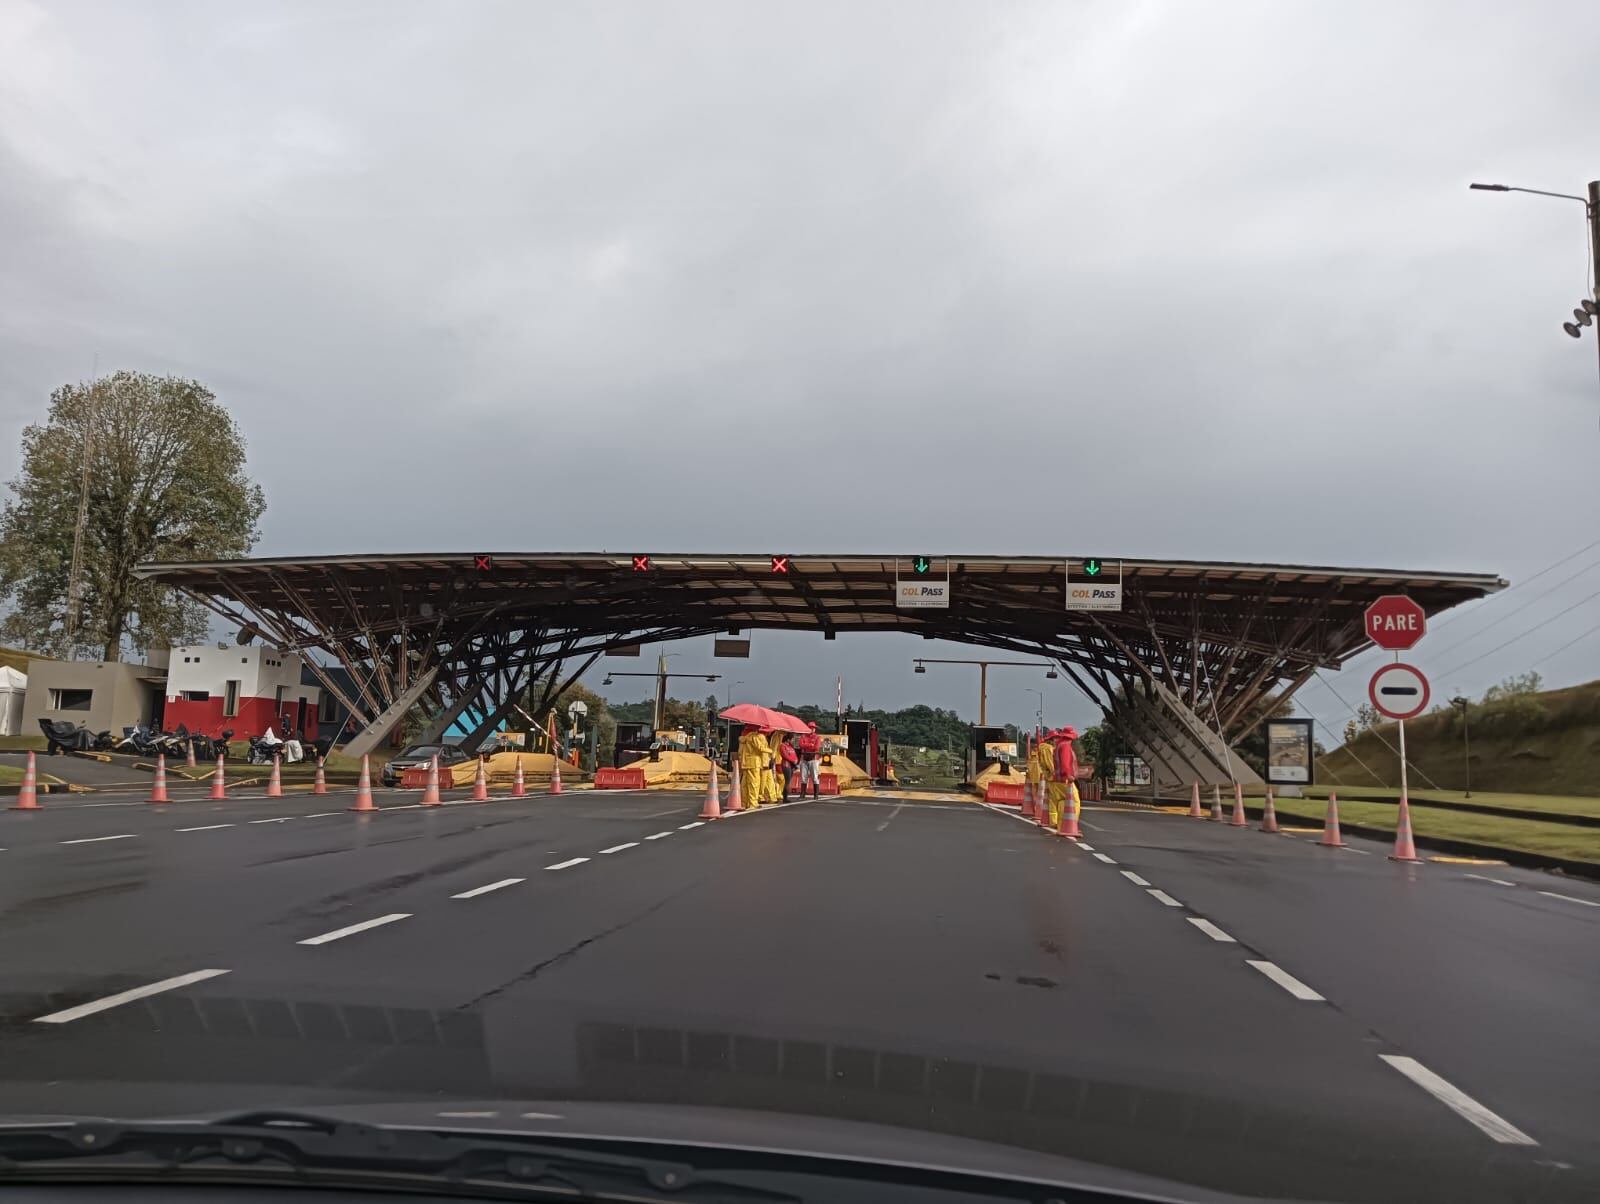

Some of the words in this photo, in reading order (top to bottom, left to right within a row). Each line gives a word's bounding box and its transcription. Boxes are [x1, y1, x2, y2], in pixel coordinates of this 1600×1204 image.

[902, 587, 919, 596] COL
[921, 587, 944, 596] PASS
[1072, 590, 1090, 598] COL
[1092, 589, 1116, 599] PASS
[1372, 614, 1418, 631] PARE
